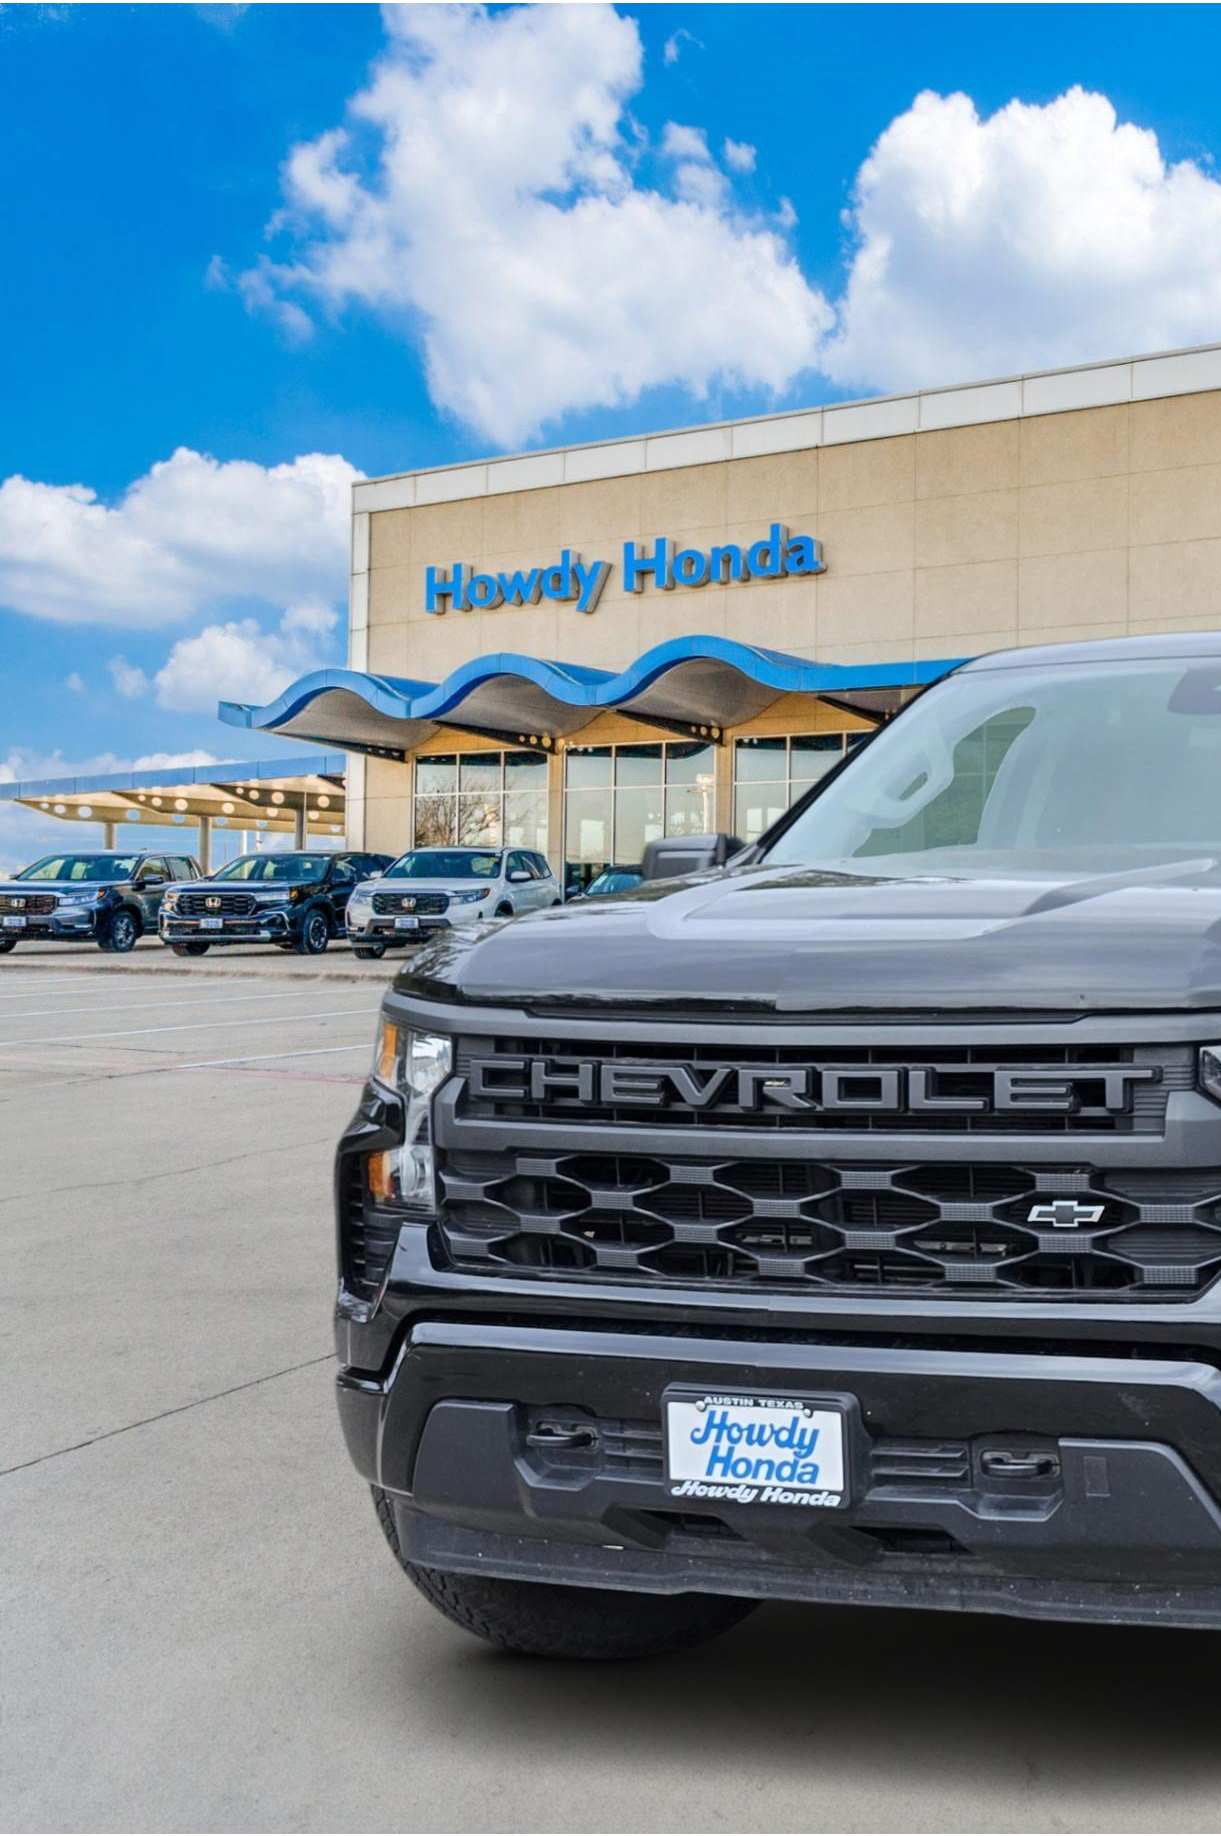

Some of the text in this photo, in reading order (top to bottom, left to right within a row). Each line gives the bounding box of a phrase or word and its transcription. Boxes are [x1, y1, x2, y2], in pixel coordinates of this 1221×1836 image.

[425, 523, 826, 613] Howdy Honda
[470, 1058, 1163, 1112] CHEVROLET
[702, 1396, 804, 1410] AUSTIN TEXAS
[690, 1410, 820, 1459] Howdy
[706, 1445, 820, 1485] Honda
[671, 1480, 841, 1508] Howdy Honda
